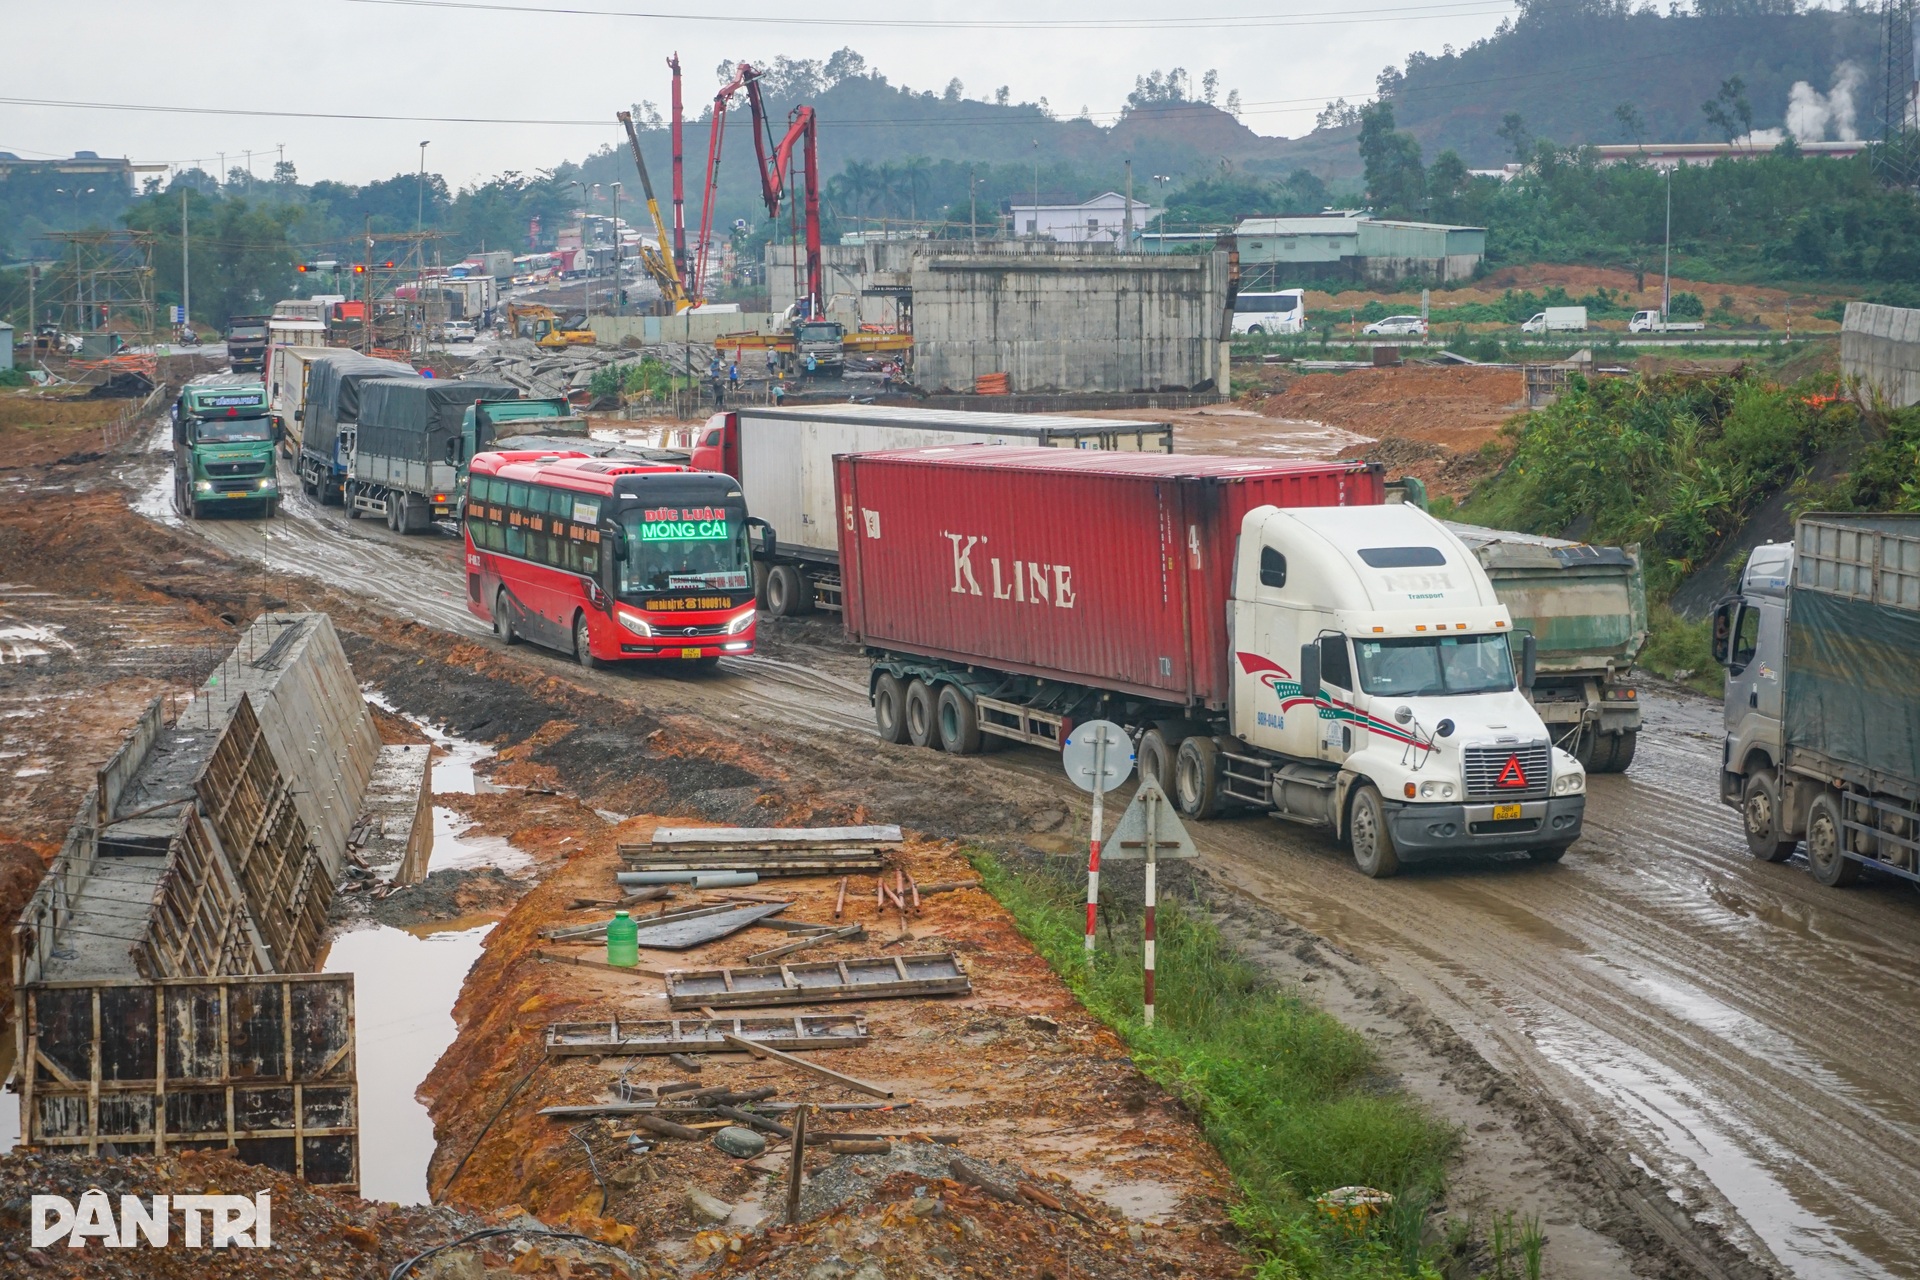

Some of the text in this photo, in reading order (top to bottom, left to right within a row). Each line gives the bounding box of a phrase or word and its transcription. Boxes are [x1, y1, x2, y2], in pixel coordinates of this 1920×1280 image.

[645, 506, 725, 522] ĐỨC LUẬN
[642, 519, 727, 537] MÓNG CÁI
[991, 557, 1077, 608] LINE
[1408, 592, 1444, 600] Transport
[1257, 711, 1284, 730] 98H-040.46
[1496, 811, 1518, 819] 040.46
